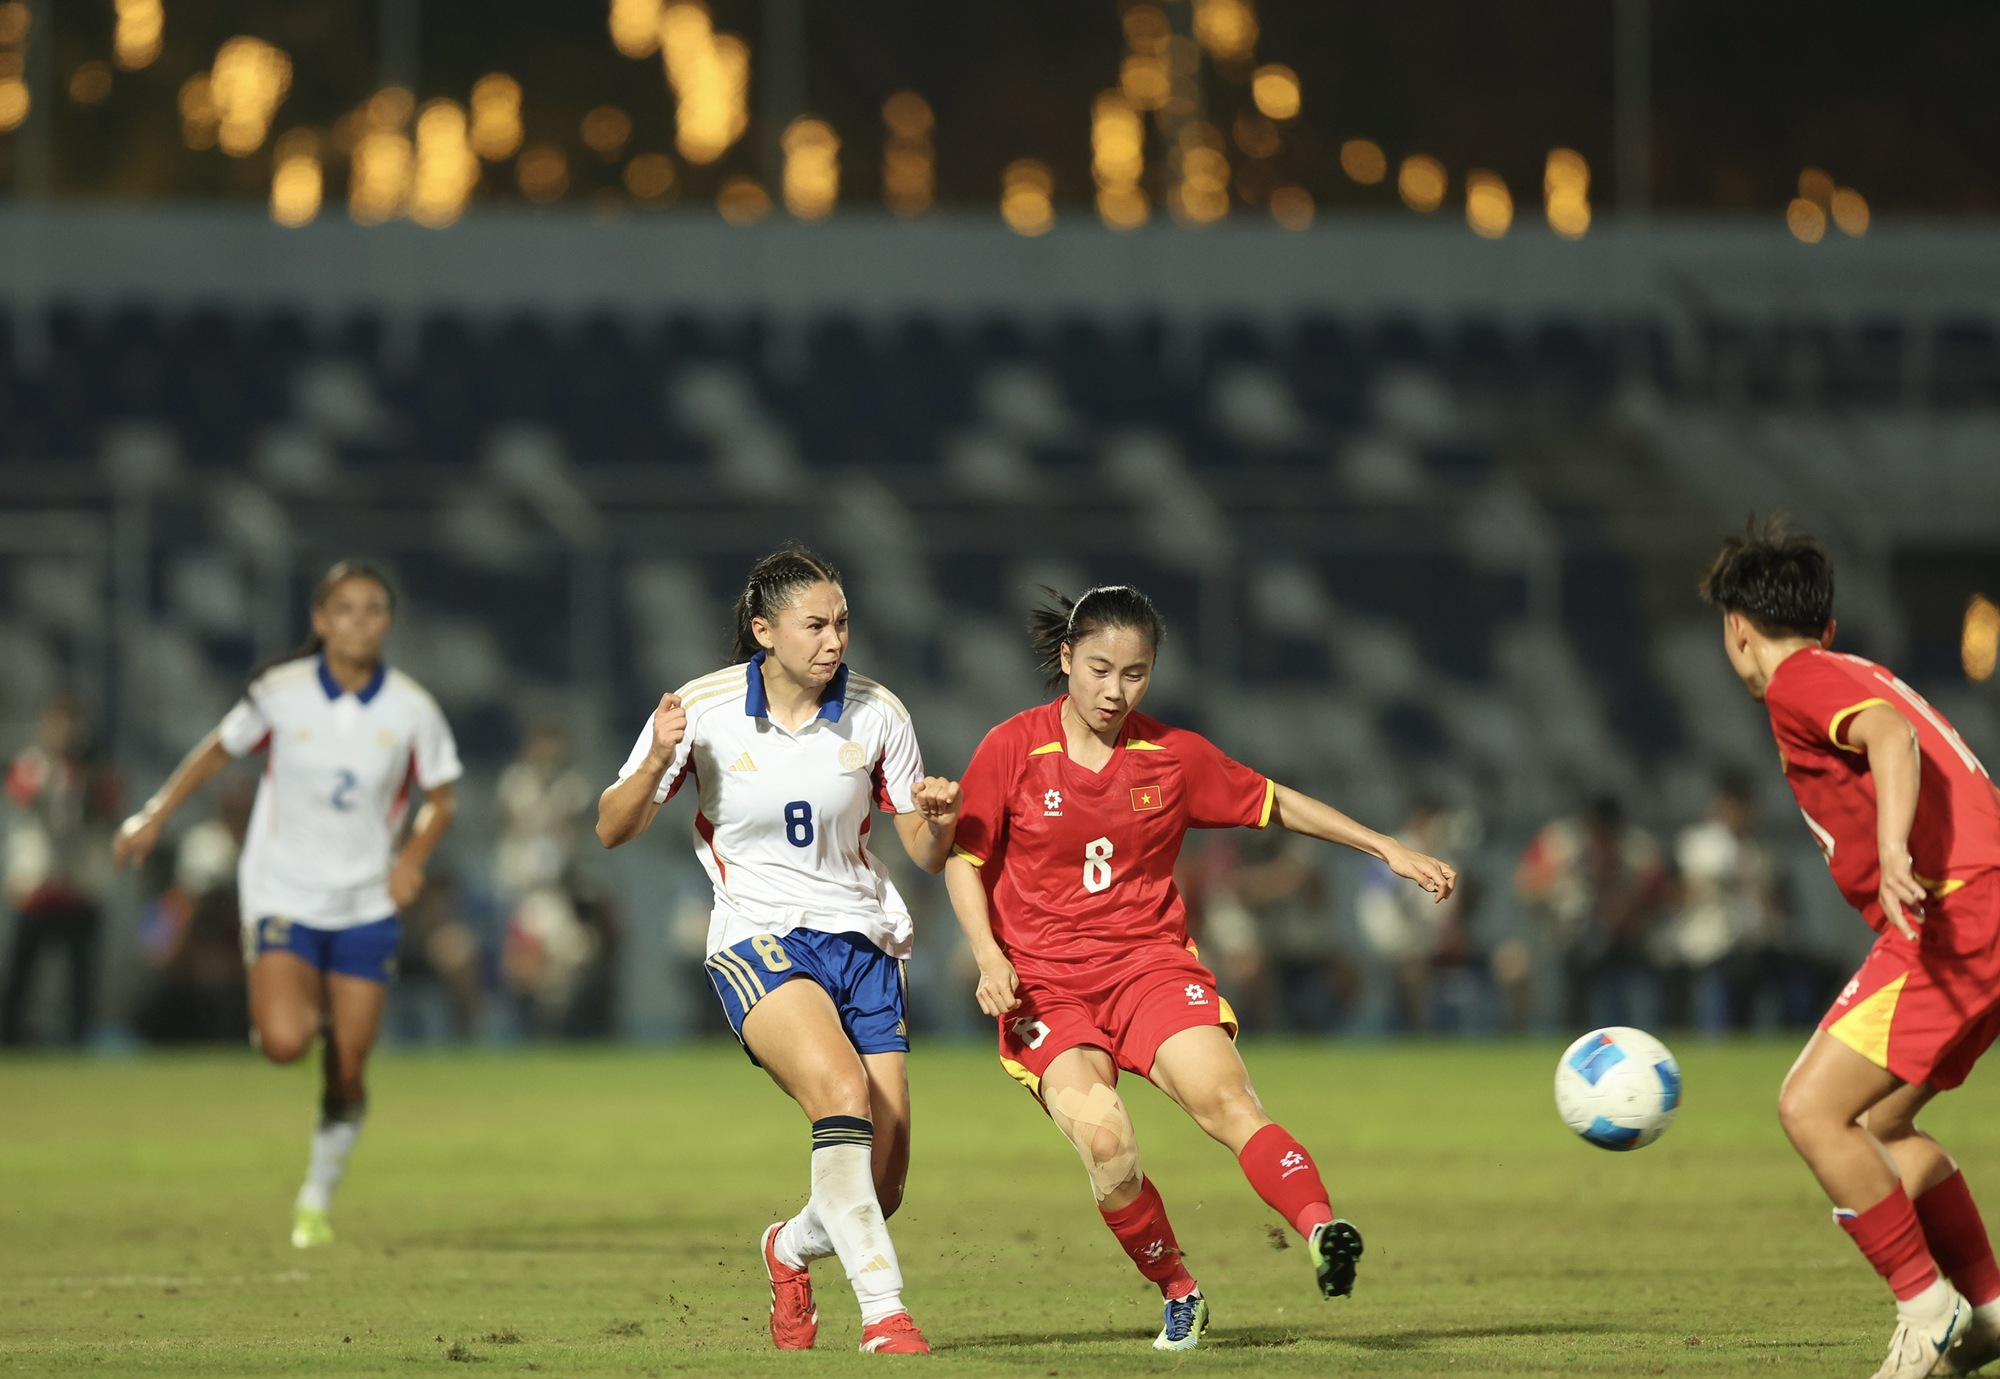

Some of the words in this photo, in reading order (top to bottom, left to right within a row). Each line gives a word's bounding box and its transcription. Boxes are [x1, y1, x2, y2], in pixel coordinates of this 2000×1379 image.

[331, 768, 357, 812] 2
[784, 800, 814, 848] 8
[1083, 836, 1114, 893] 8
[751, 934, 792, 972] 8
[1011, 1016, 1052, 1050] 8
